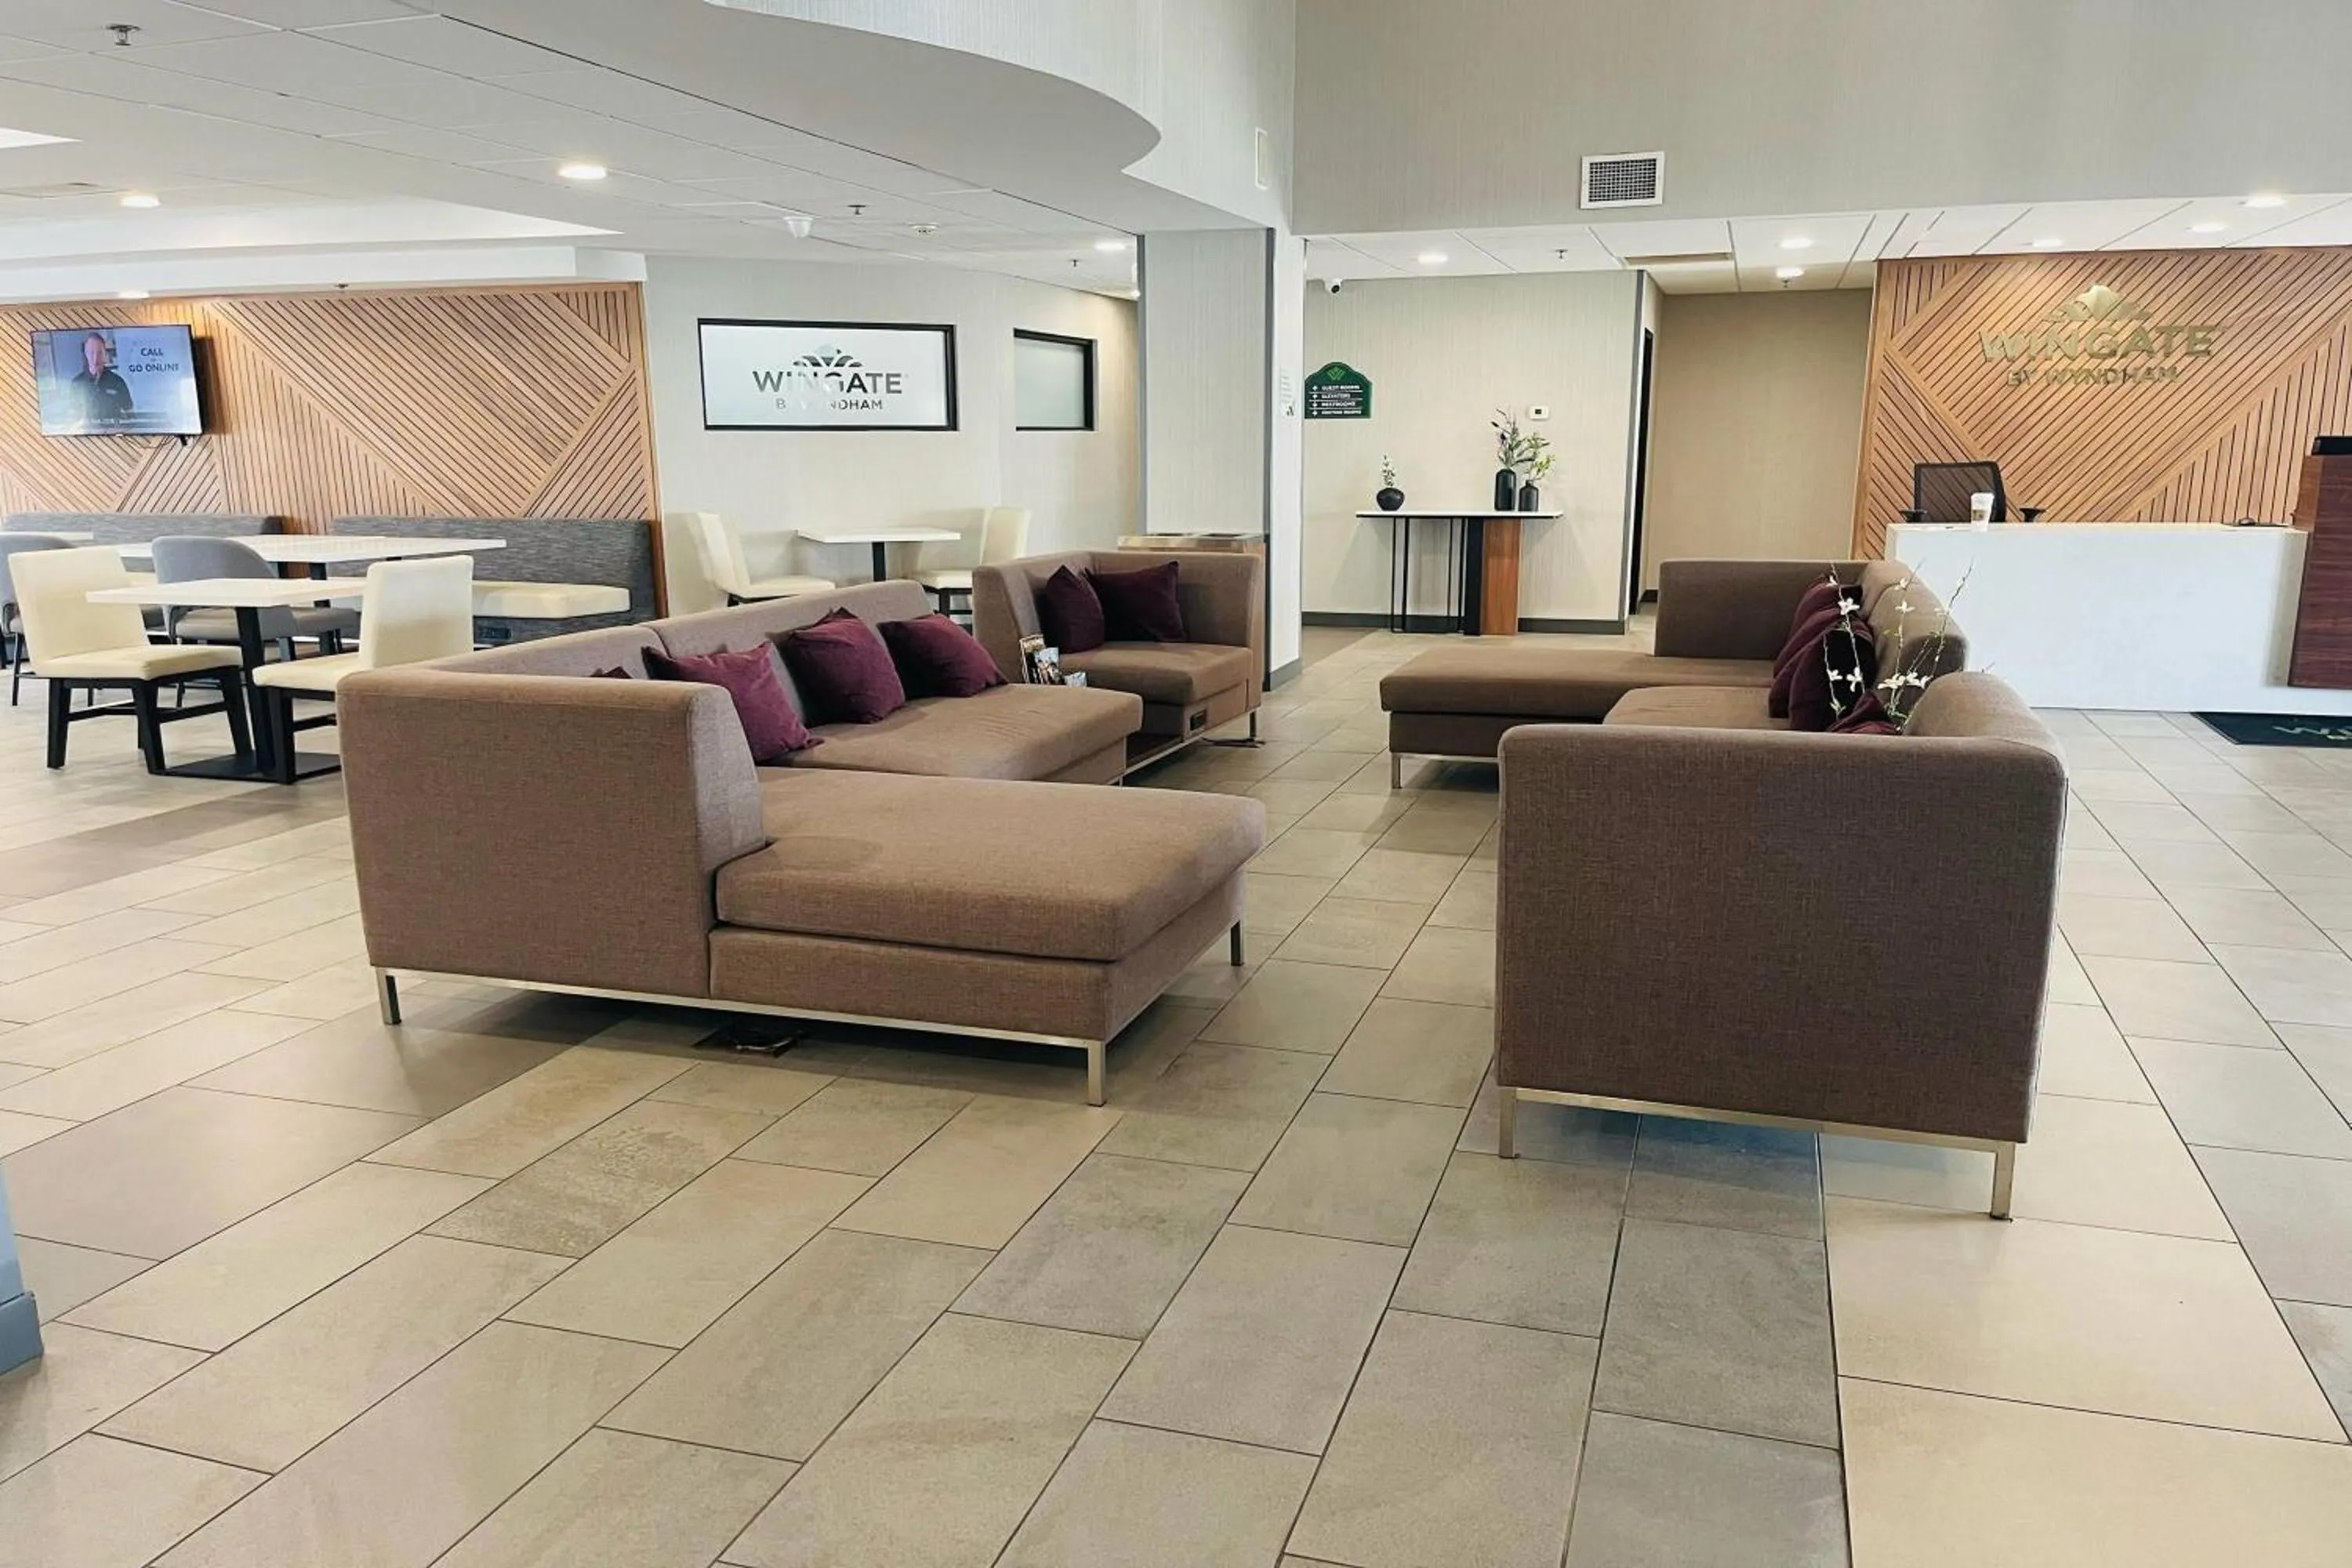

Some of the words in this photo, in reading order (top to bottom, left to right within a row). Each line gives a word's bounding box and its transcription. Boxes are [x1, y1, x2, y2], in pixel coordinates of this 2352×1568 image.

[1979, 325, 2217, 361] WINGATE
[140, 347, 163, 357] CALL
[129, 363, 143, 372] GO
[2007, 368, 2032, 387] BY
[2045, 366, 2179, 386] WYNDHAM
